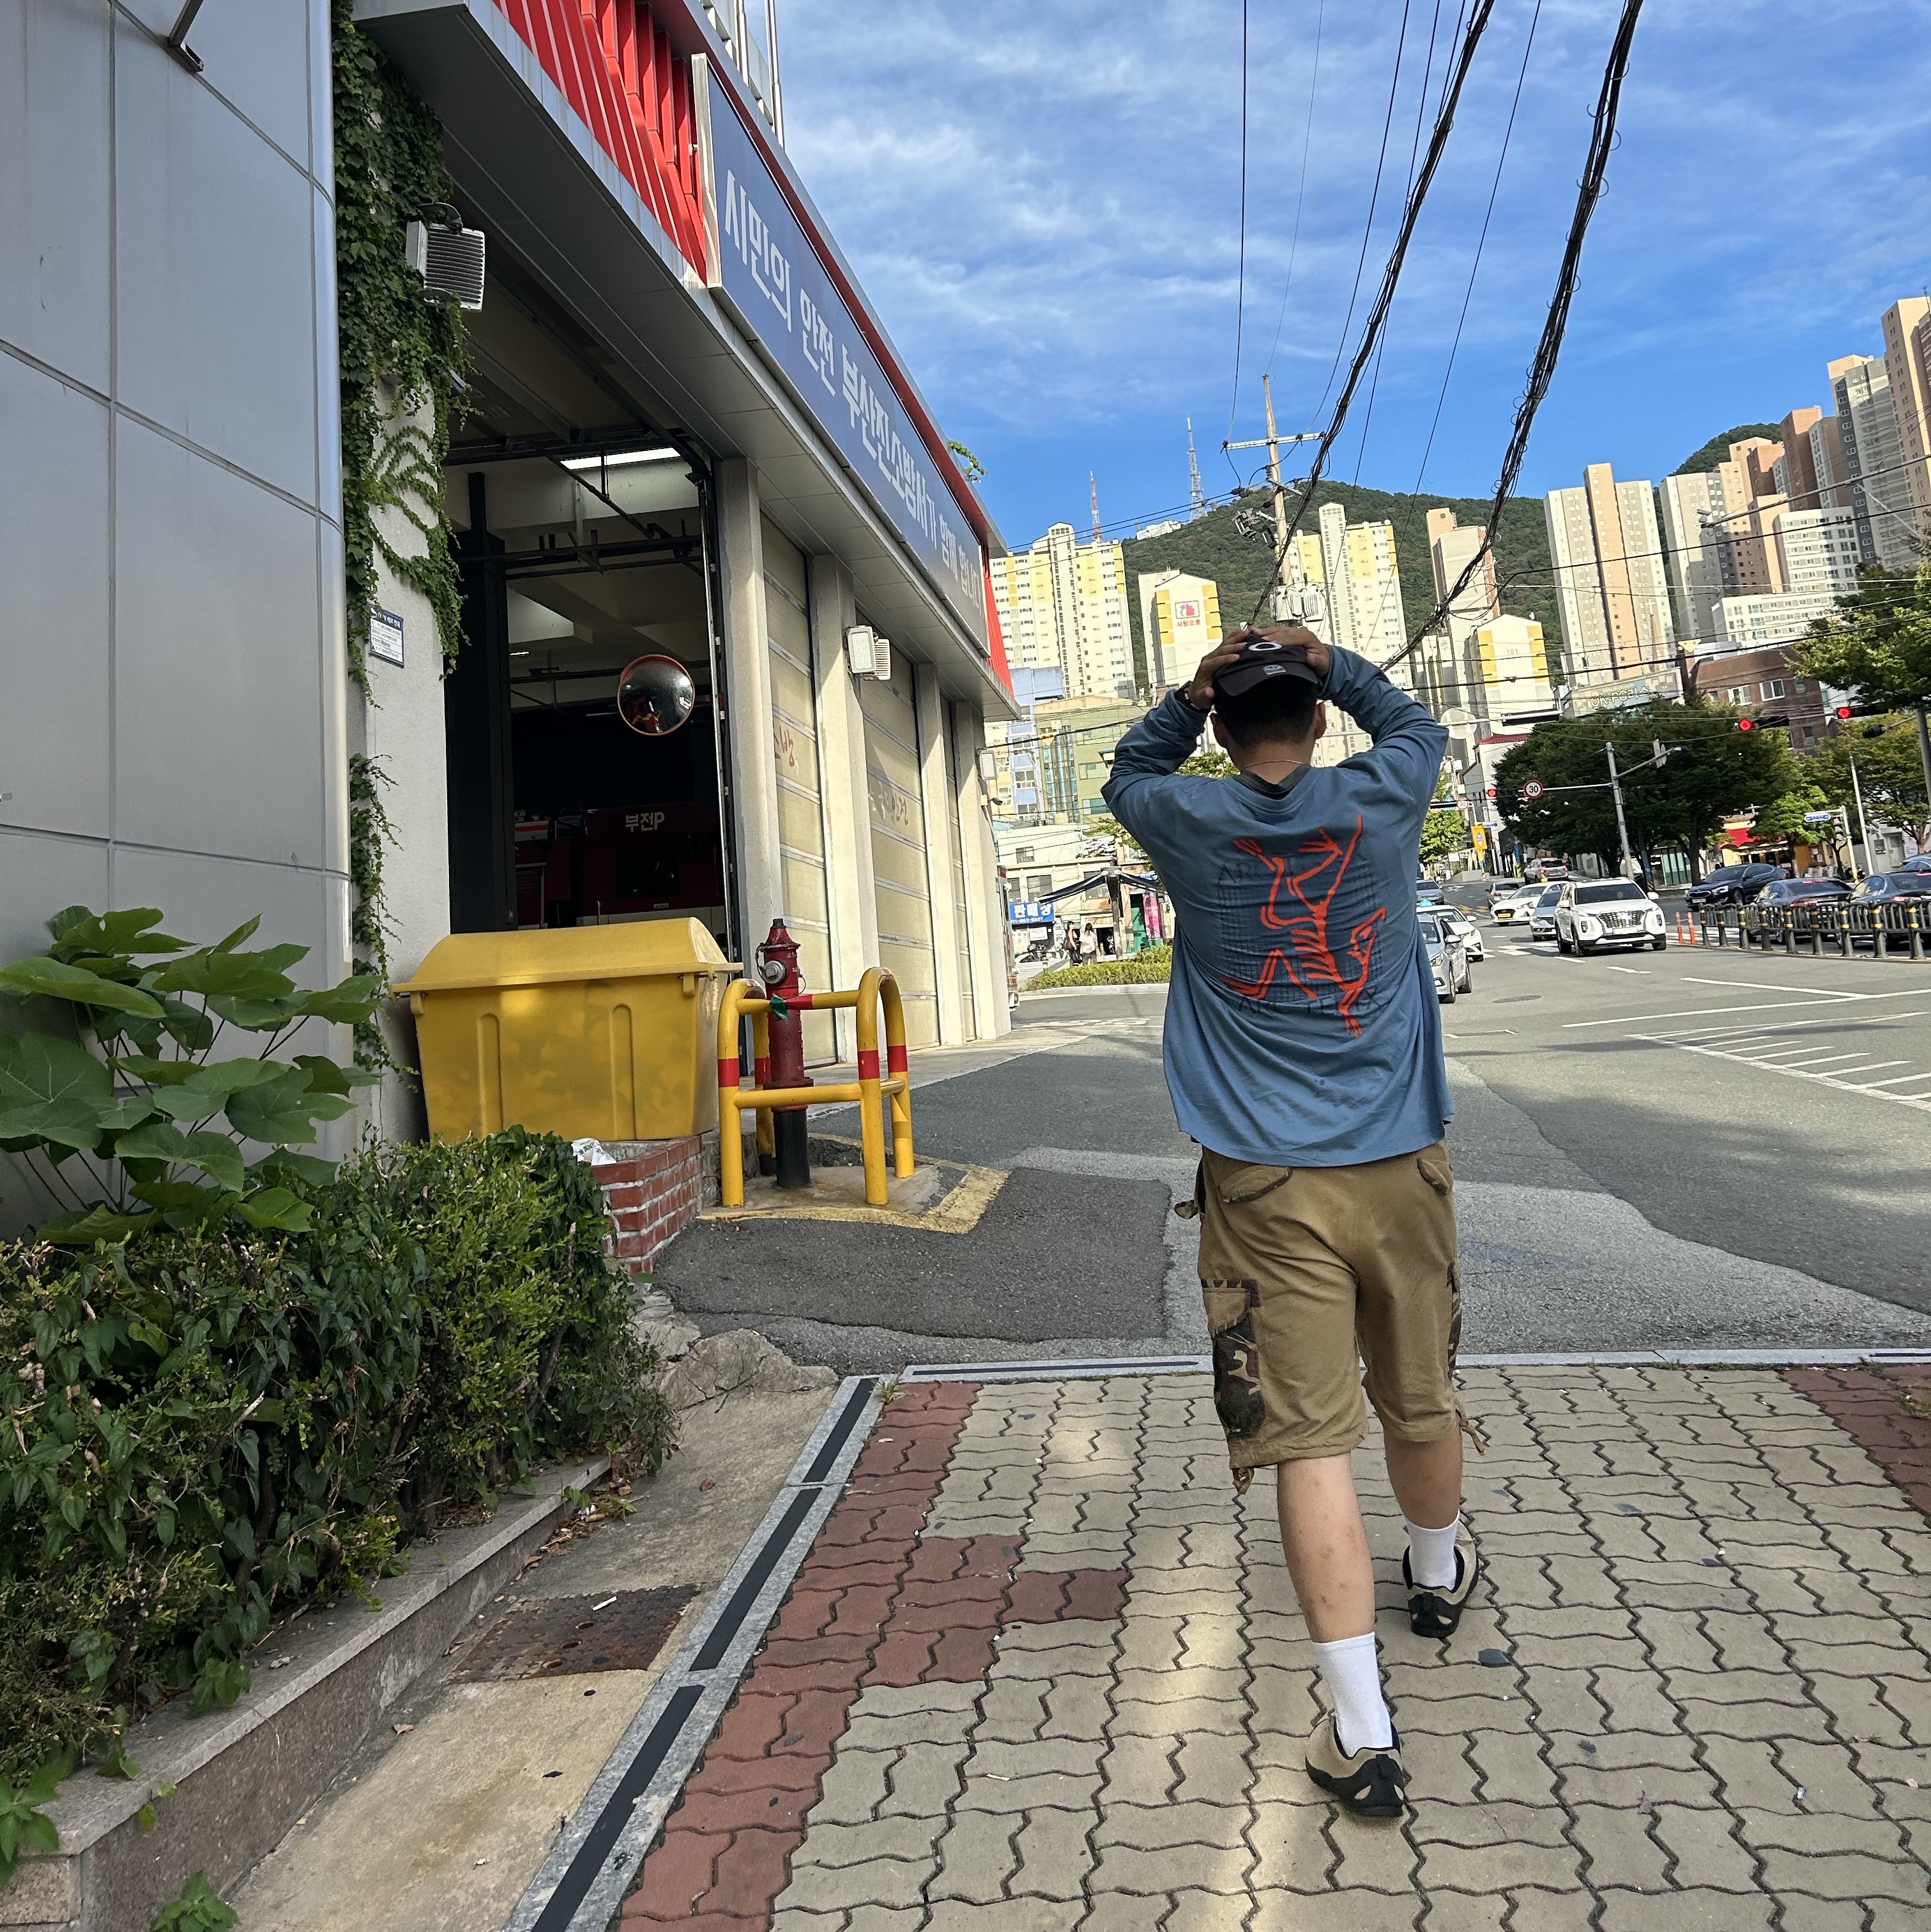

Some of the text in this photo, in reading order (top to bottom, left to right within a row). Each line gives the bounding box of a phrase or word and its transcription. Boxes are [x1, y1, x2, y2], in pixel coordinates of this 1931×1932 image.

[724, 169, 792, 333] 시민의
[800, 287, 836, 397] 안전
[841, 343, 938, 551] 부산진소방서가
[938, 512, 959, 582] 함께
[1529, 785, 1539, 793] 30
[625, 811, 665, 833] 부전P
[1013, 902, 1053, 918] 판매상
